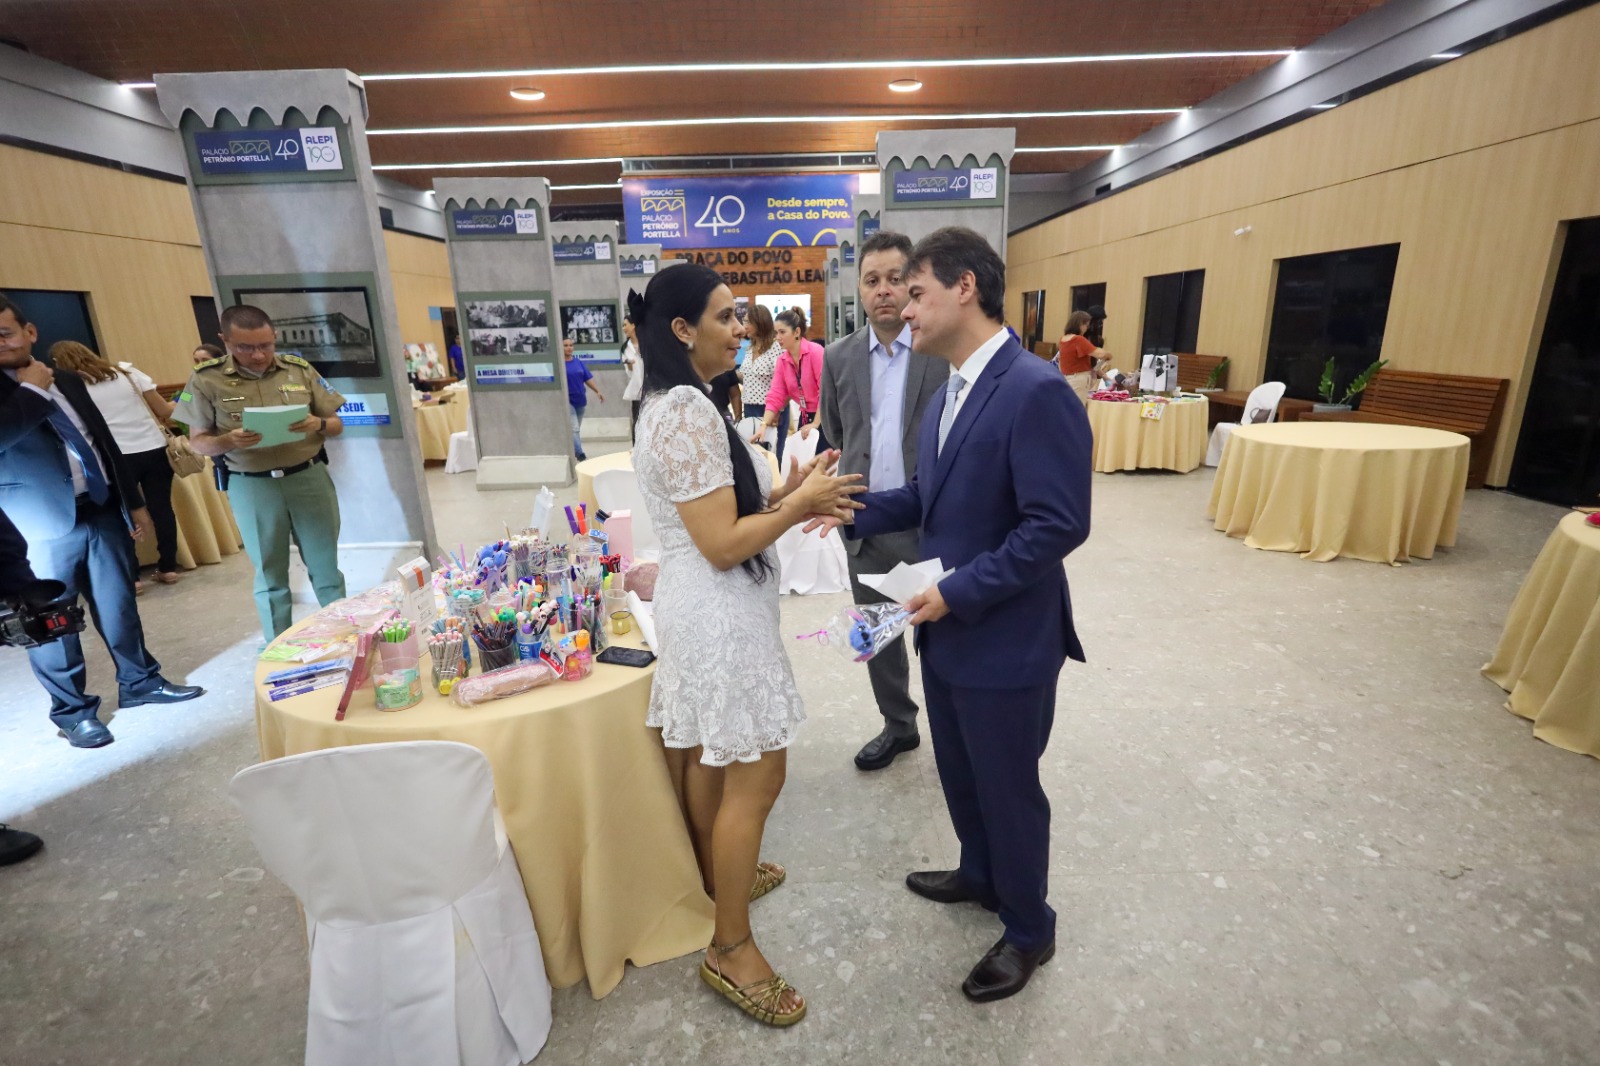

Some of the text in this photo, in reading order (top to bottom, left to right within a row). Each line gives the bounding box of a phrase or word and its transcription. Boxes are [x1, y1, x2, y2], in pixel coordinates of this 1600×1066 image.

[305, 135, 333, 144] ALEPI
[201, 146, 230, 156] PALÁCIO
[274, 138, 299, 160] 40
[307, 145, 335, 163] 190
[203, 154, 236, 164] PETRÔNIO
[949, 175, 968, 191] 40
[641, 188, 674, 196] EXPOSIÇÃO
[767, 197, 848, 208] Desde sempre,
[641, 213, 673, 222] PALÁCIO
[694, 195, 745, 236] 40
[767, 209, 851, 220] a Casa do Povo.
[498, 214, 514, 228] 40
[642, 221, 679, 230] PETRÔNIO
[643, 230, 681, 238] PORTELLA
[727, 251, 749, 265] DO
[753, 250, 793, 264] POVO
[721, 267, 792, 285] EBASTIÃO
[343, 402, 365, 413] SEDE
